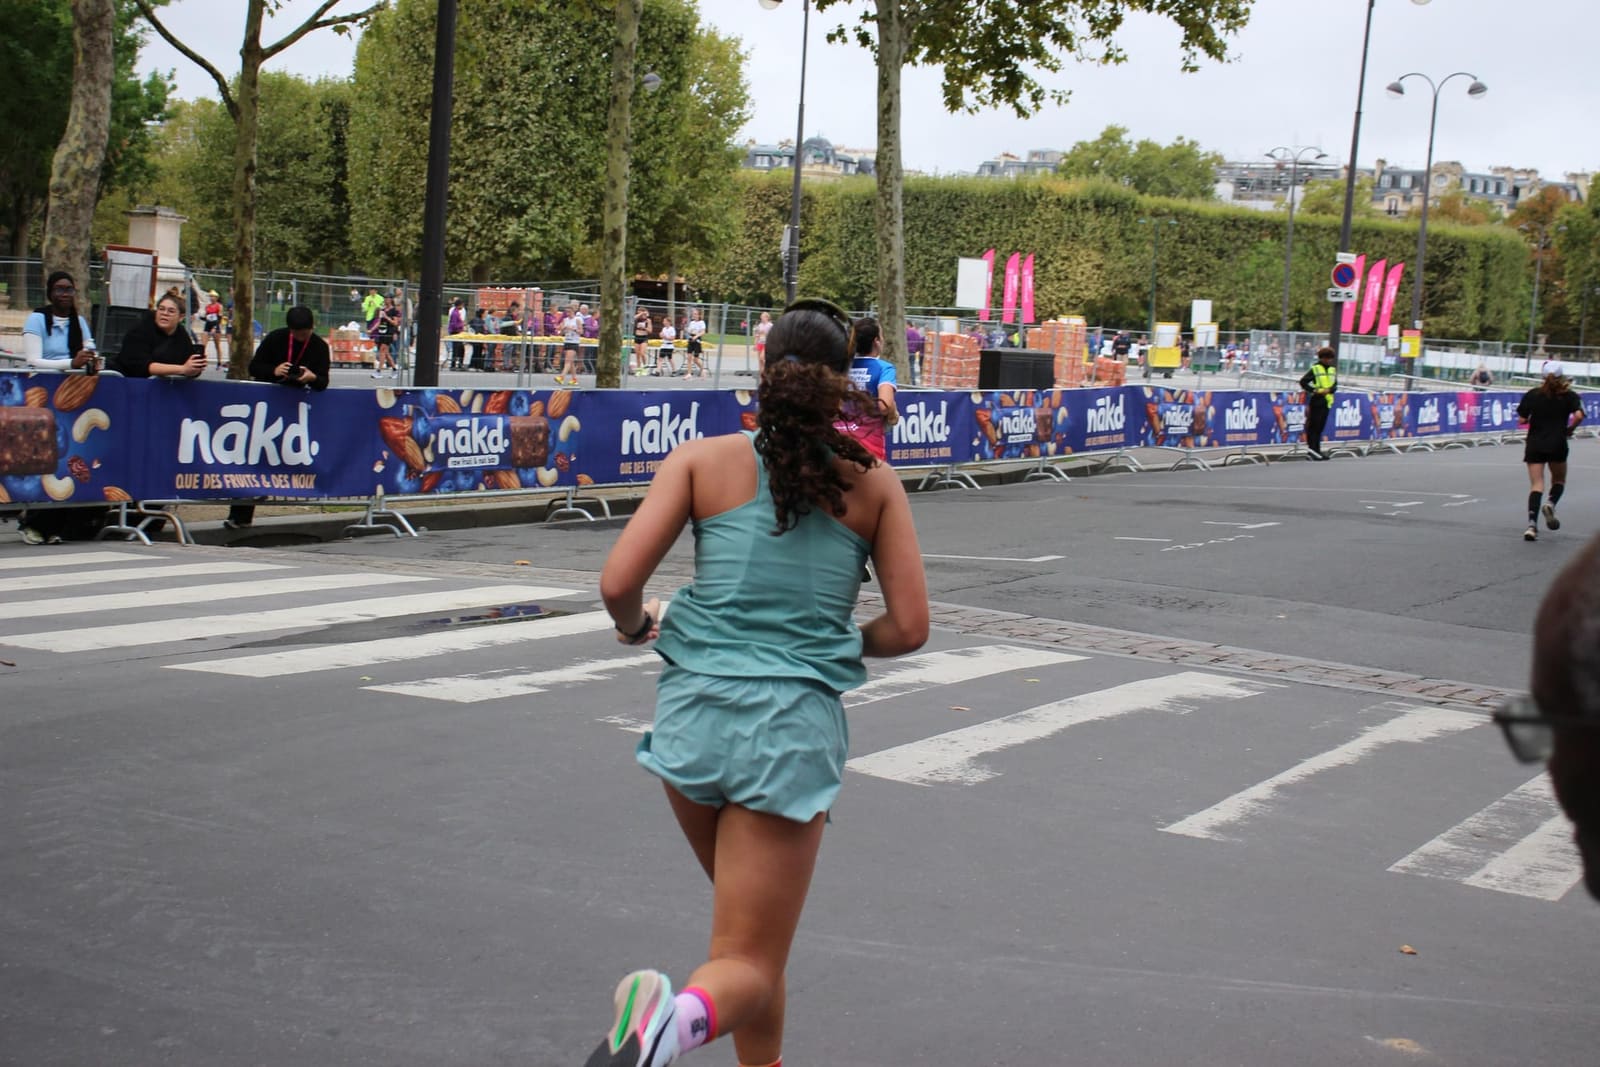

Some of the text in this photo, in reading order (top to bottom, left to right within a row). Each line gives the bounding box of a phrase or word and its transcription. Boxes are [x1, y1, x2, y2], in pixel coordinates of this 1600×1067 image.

[178, 401, 320, 466] nākd.
[438, 417, 510, 455] nākd.
[176, 474, 317, 489] QUE DES FRUITS & DES NOIX
